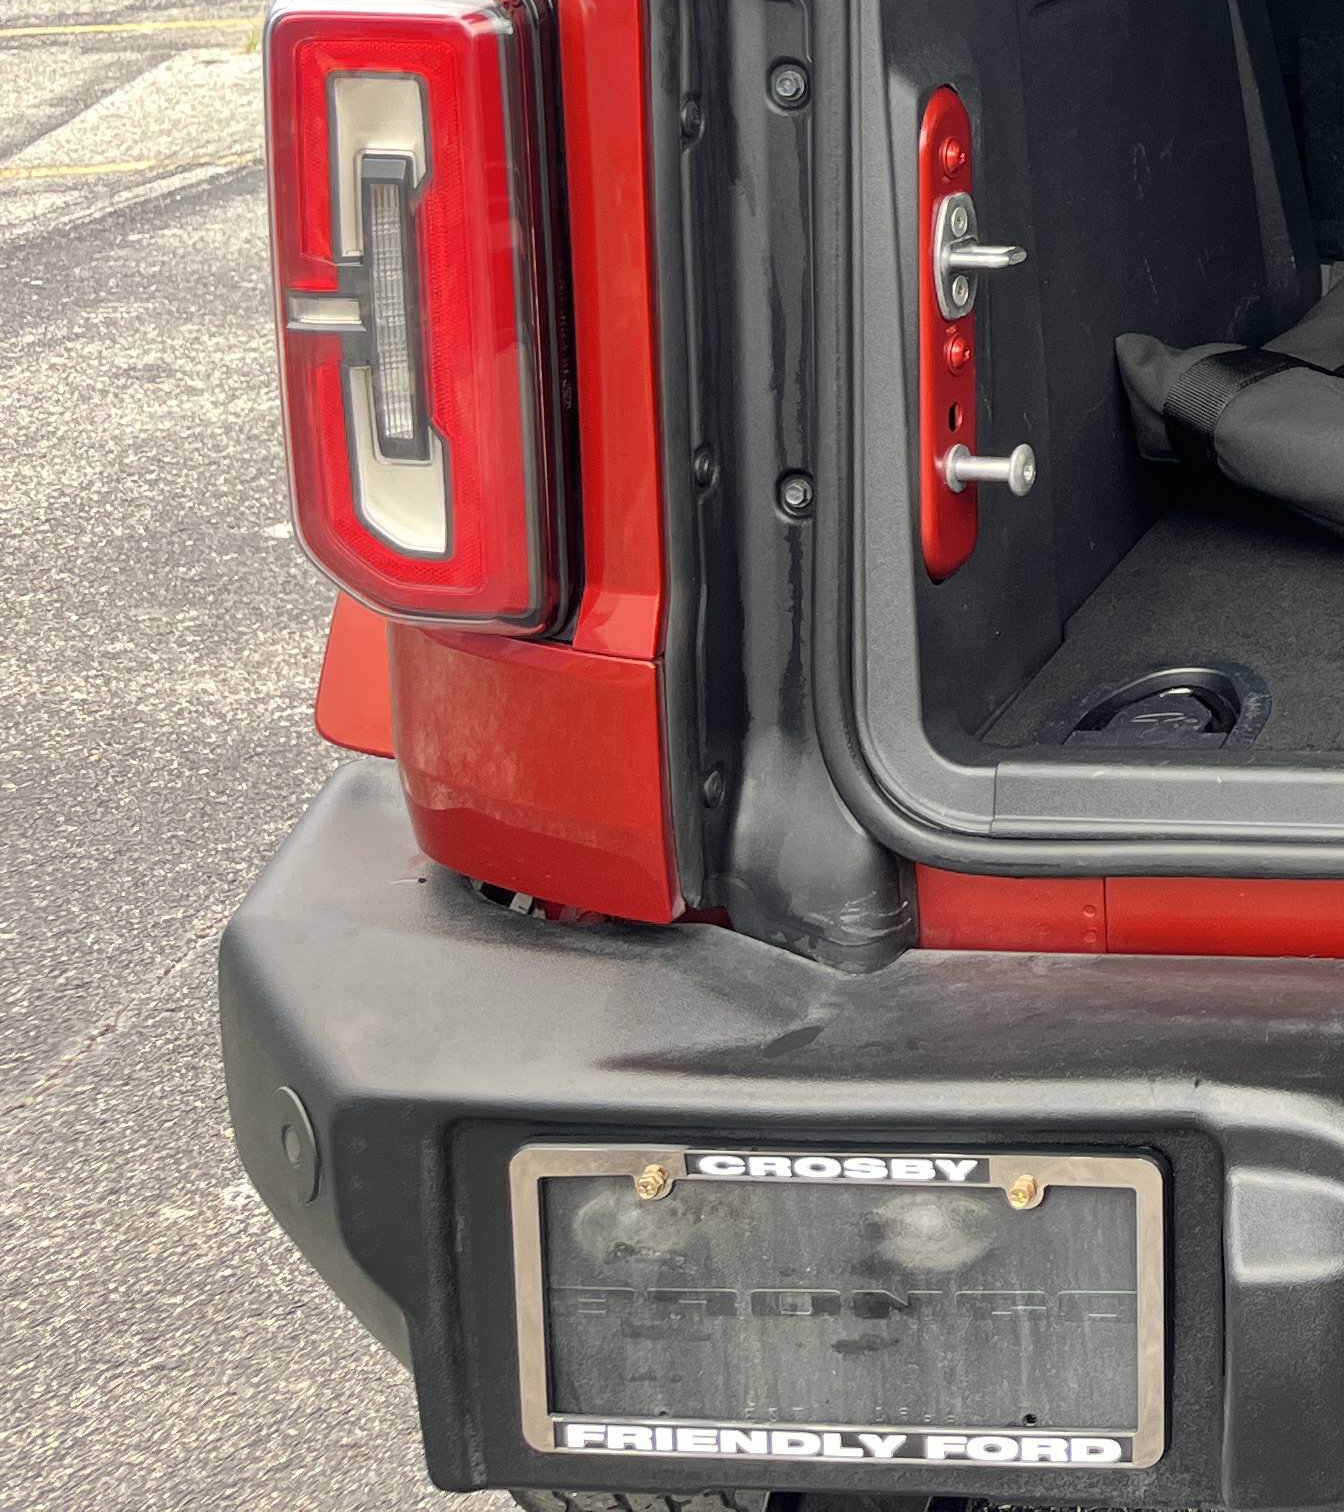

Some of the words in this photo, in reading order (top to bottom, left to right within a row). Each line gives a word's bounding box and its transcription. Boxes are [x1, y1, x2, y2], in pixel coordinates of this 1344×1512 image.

[698, 1154, 979, 1183] CROSBY
[565, 1424, 907, 1459] FRIENDLY
[926, 1435, 1122, 1463] FORD
